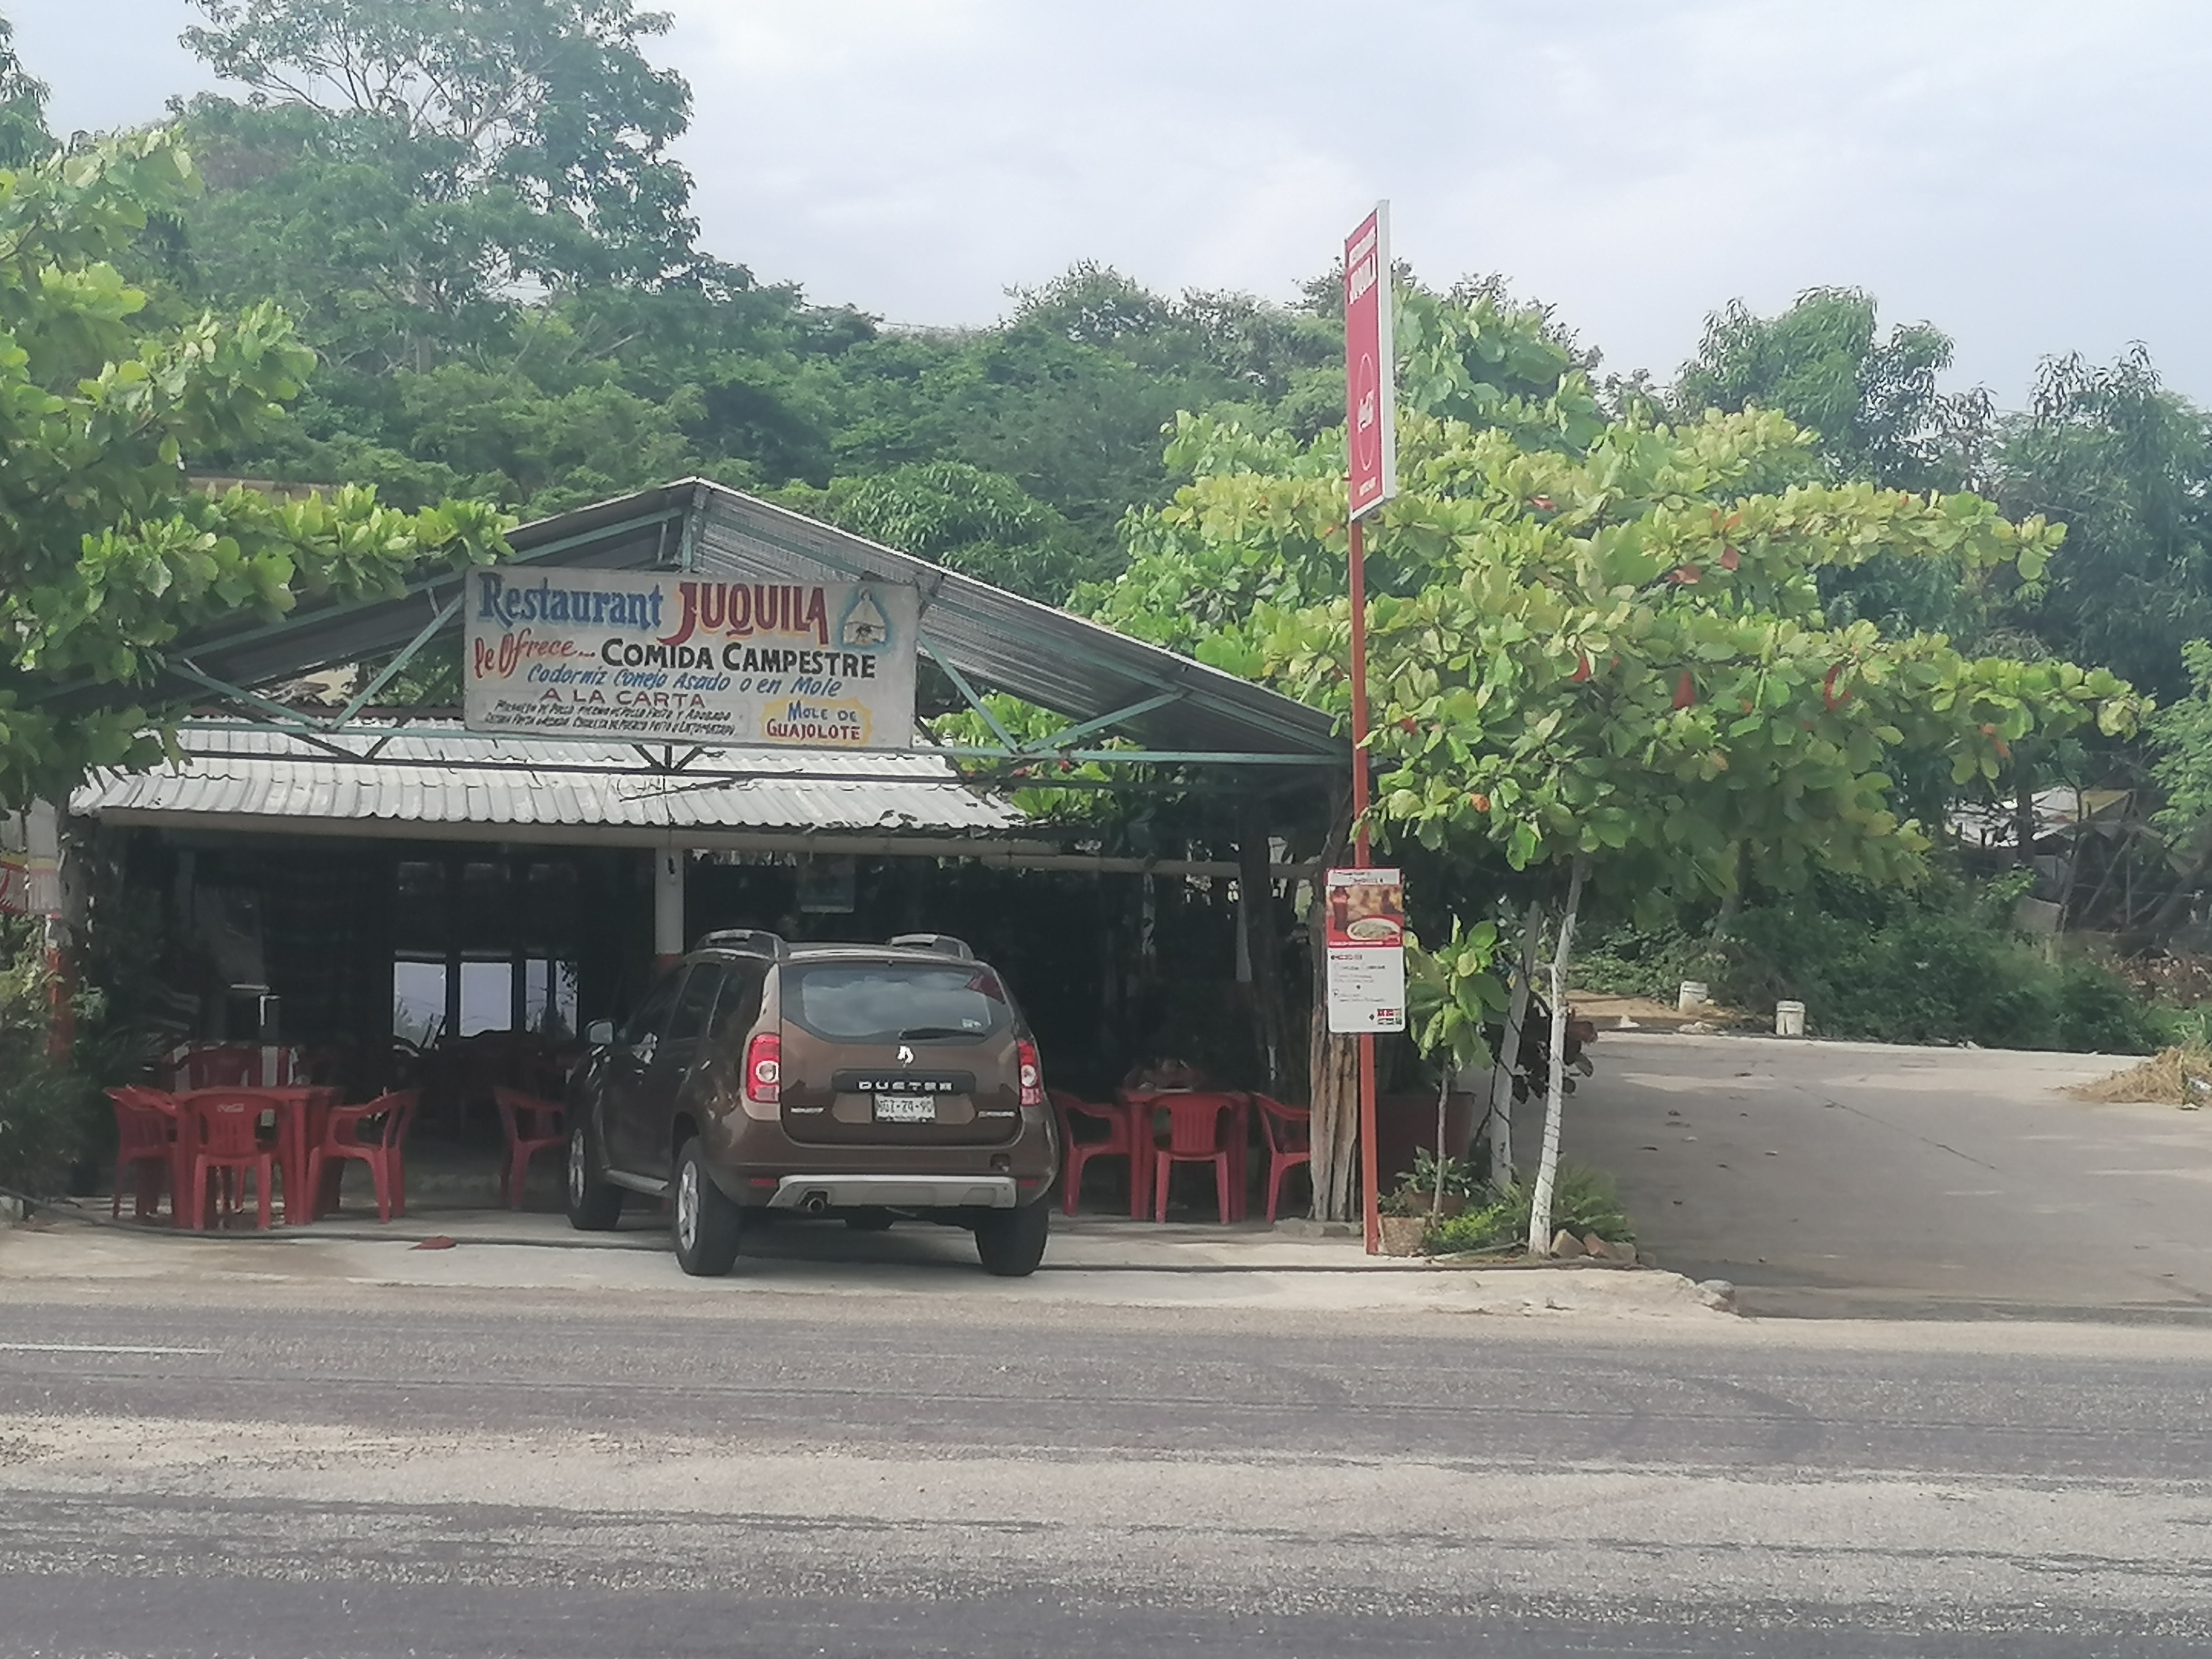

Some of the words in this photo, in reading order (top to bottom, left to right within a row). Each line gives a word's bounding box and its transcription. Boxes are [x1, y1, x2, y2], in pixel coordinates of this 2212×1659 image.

[478, 572, 664, 630] Restaurant
[656, 582, 829, 646] JUQUILA
[602, 638, 714, 670] COMIDA
[722, 642, 875, 679] CAMPESTRE
[527, 663, 608, 685] Codorniz
[613, 668, 668, 690] Conejo
[672, 672, 731, 692] Asado
[757, 678, 782, 695] en
[790, 676, 843, 697] Mole
[540, 687, 562, 702] A
[573, 688, 606, 704] LA
[617, 690, 705, 708] CARTA
[766, 718, 861, 740] GUAJOLOTE
